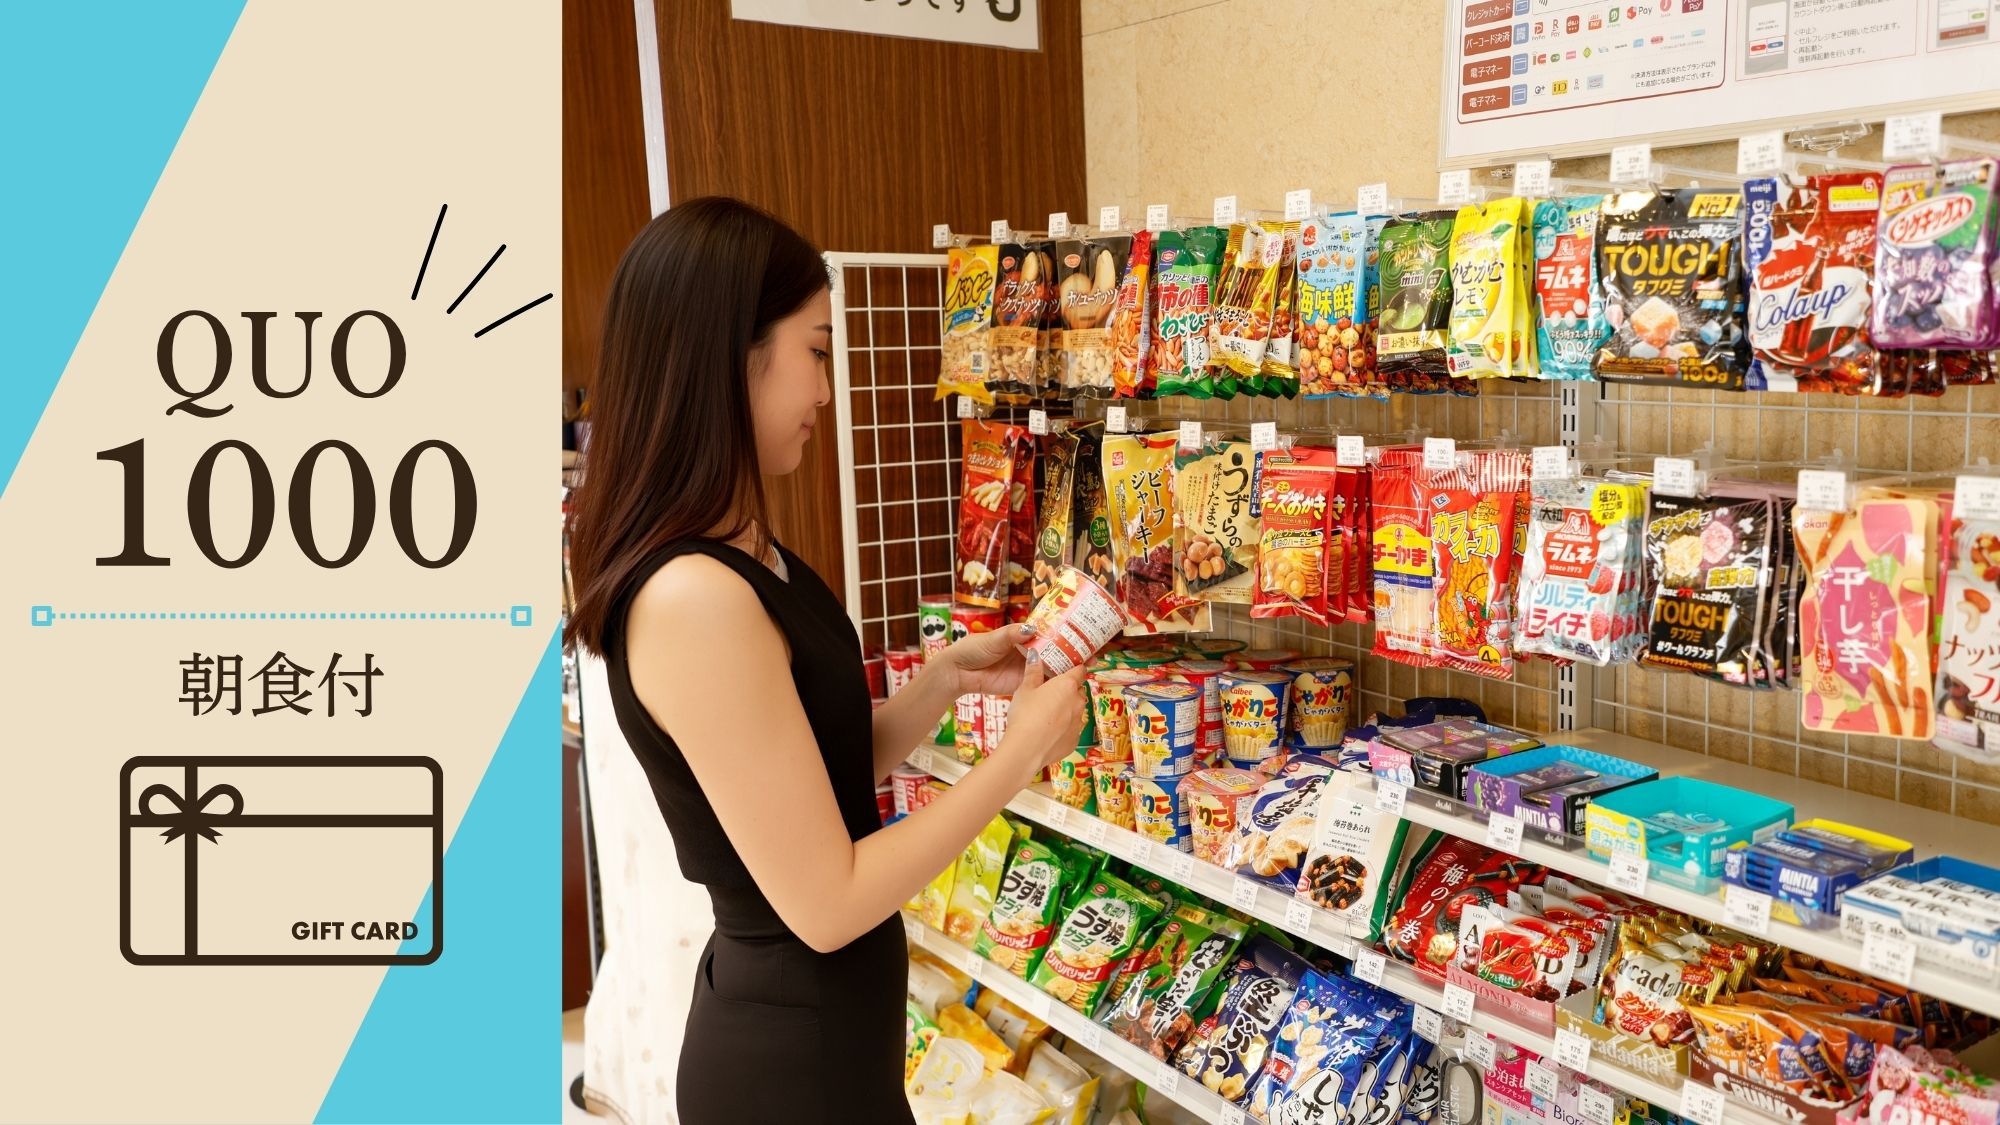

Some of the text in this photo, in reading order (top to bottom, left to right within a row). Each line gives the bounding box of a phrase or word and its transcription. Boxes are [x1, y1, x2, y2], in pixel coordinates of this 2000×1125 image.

[1467, 3, 1511, 22] クレジットカード
[1466, 32, 1511, 49] バーコード決済
[1470, 65, 1503, 79] 電子マネー
[1469, 95, 1503, 108] 電子マネー
[1750, 183, 1772, 193] meiji
[1604, 241, 1732, 277] TOUGH
[1538, 266, 1587, 290] ラムネ
[1632, 279, 1688, 296] タフグミ
[1299, 279, 1355, 321] 海味鮮
[1454, 287, 1489, 306] レモン
[1158, 312, 1210, 341] わさび
[1147, 468, 1166, 528] ビーフ
[1222, 452, 1250, 548] うずらの
[1261, 489, 1327, 521] チーズおかき
[1131, 470, 1152, 564] ジャーキー
[1540, 508, 1564, 522] 大粒
[1373, 543, 1428, 568] チーかま
[1546, 541, 1593, 565] ラムネ
[1530, 607, 1587, 637] ライチ
[1655, 599, 1730, 633] TOUGH
[1831, 565, 1873, 676] 干し芋
[1669, 627, 1703, 643] タフグミ
[1230, 686, 1253, 696] Calbee
[1513, 804, 1548, 829] MINTIA
[1778, 867, 1820, 892] MINTIA
[1397, 863, 1469, 945] 梅のり巻
[1450, 972, 1513, 1008] ALMOND
[1712, 1071, 1808, 1122] CRUNKY
